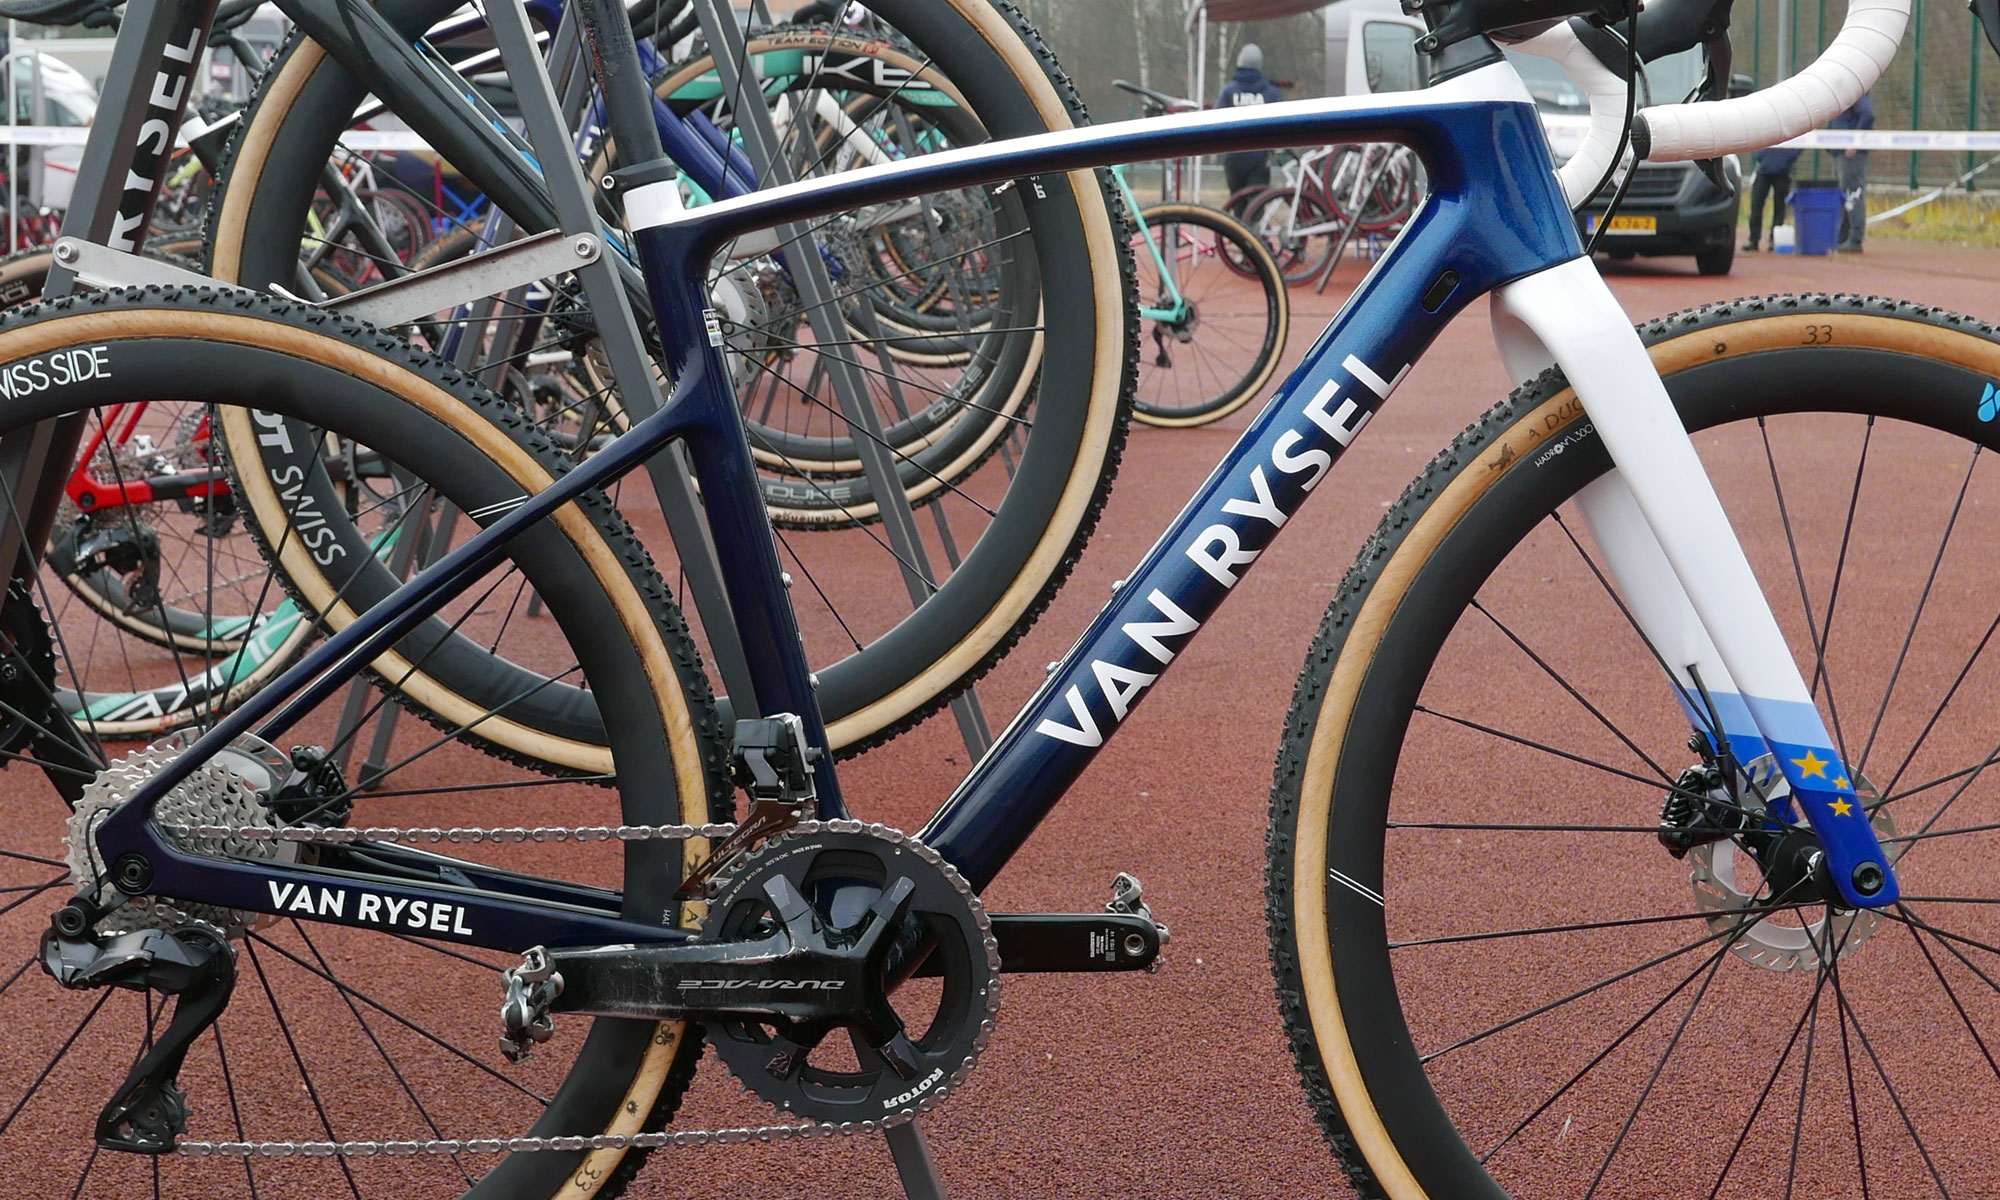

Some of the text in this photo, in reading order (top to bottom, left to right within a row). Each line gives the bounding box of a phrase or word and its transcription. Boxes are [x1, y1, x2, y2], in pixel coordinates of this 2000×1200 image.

[768, 36, 862, 50] TEAM EDITION
[1801, 324, 1834, 346] 33
[50, 346, 112, 385] SIDE
[766, 485, 851, 500] DUKE
[271, 465, 347, 566] SWISS
[775, 512, 838, 523] challenge
[1035, 353, 1412, 748] VAN RYSEL
[713, 816, 766, 863] ULTEGRA
[268, 880, 473, 937] VAN RYSEL
[676, 980, 846, 990] DURA-ACE
[882, 1067, 944, 1109] ROTOR
[575, 1158, 602, 1192] 33
